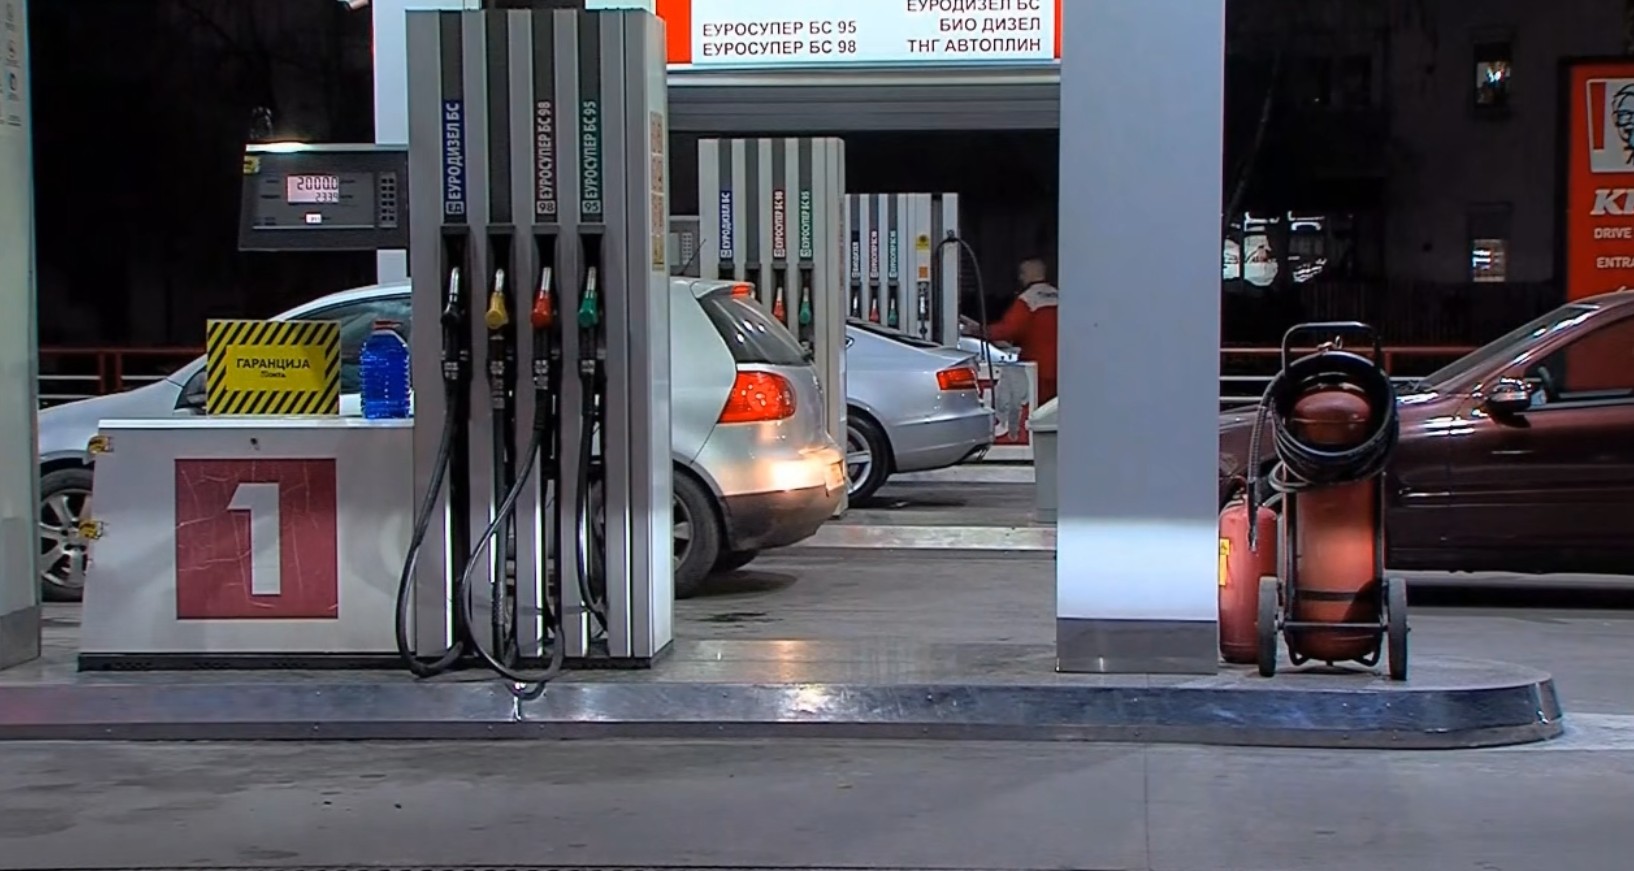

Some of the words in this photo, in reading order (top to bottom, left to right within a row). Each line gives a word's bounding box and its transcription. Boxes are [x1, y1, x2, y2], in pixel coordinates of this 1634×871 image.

[907, 0, 1011, 13] ЕУРОДИЗЕЛ
[1017, 0, 1040, 11] БС
[702, 22, 804, 37] ЕУРОСУПЕР
[809, 21, 832, 35] БС
[838, 20, 857, 34] 95
[939, 18, 977, 32] БИО
[982, 17, 1040, 33] ДИЗЕЛ
[702, 41, 804, 56] ЕУРОСУПЕР
[809, 40, 832, 54] БС
[838, 40, 857, 54] 98
[907, 39, 940, 52] ТНГ
[945, 38, 1041, 52] АВТОПЛИН
[446, 102, 460, 120] БС
[537, 101, 552, 116] 98
[583, 101, 597, 115] 95
[538, 116, 552, 133] БС
[583, 115, 598, 132] БС
[446, 123, 464, 200] ЕУРОДИЗЕЛ
[538, 134, 553, 200] ЕУРОСУПЕР
[583, 134, 598, 199] ЕУРОСУПЕР
[538, 202, 555, 212] 98
[584, 202, 599, 212] 95
[1594, 227, 1633, 239] DRIVE
[236, 358, 310, 370] ГАРАНЦИЈА
[226, 482, 281, 595] 1
